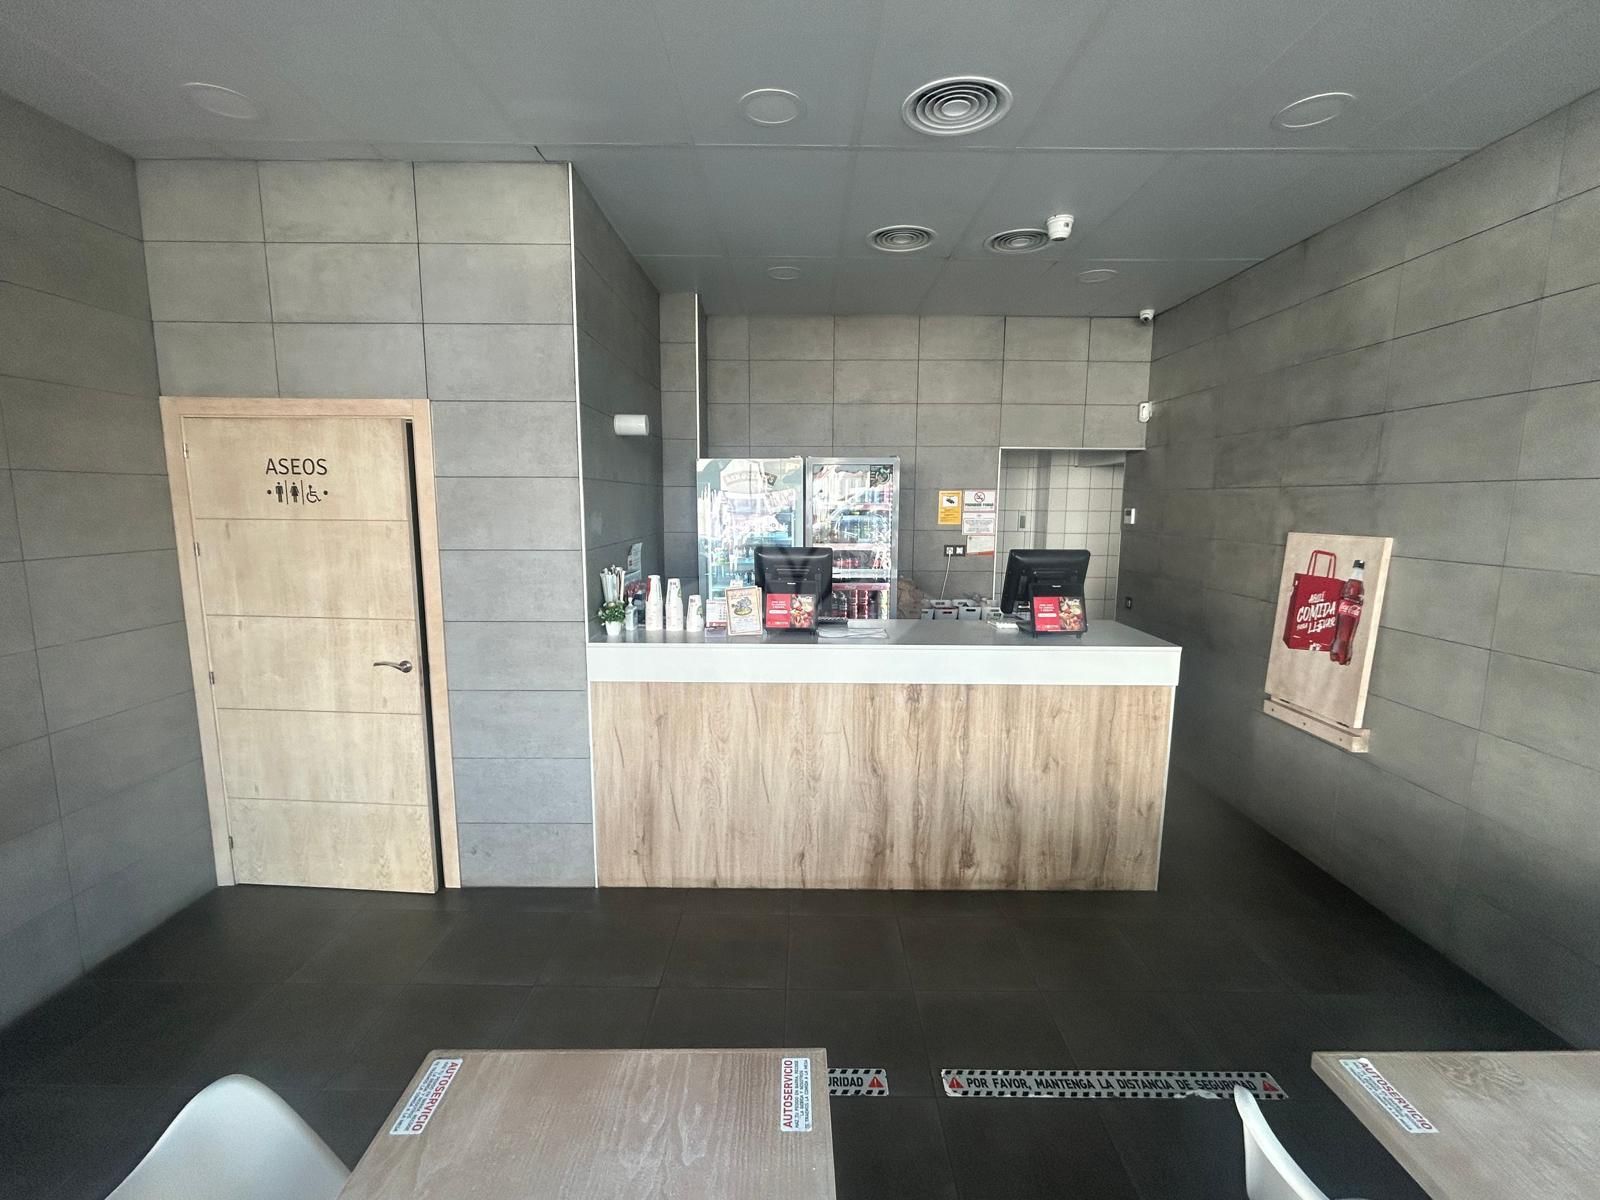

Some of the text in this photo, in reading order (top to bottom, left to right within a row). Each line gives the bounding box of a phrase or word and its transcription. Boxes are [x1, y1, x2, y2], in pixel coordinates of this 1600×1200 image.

[265, 457, 328, 476] ASEOS
[1296, 601, 1337, 623] COMIDA
[412, 1062, 459, 1131] AUTOSERVICIO
[782, 1060, 794, 1128] AUTOSERVICIO
[966, 1077, 989, 1088] POR
[992, 1077, 1032, 1090] FAVOR,
[1034, 1078, 1095, 1090] MANTENGA
[1097, 1078, 1114, 1090] LA
[1116, 1079, 1174, 1090] DISTANCIA
[1175, 1079, 1192, 1090] DE
[1359, 1062, 1433, 1130] AUTOSERVICIO
